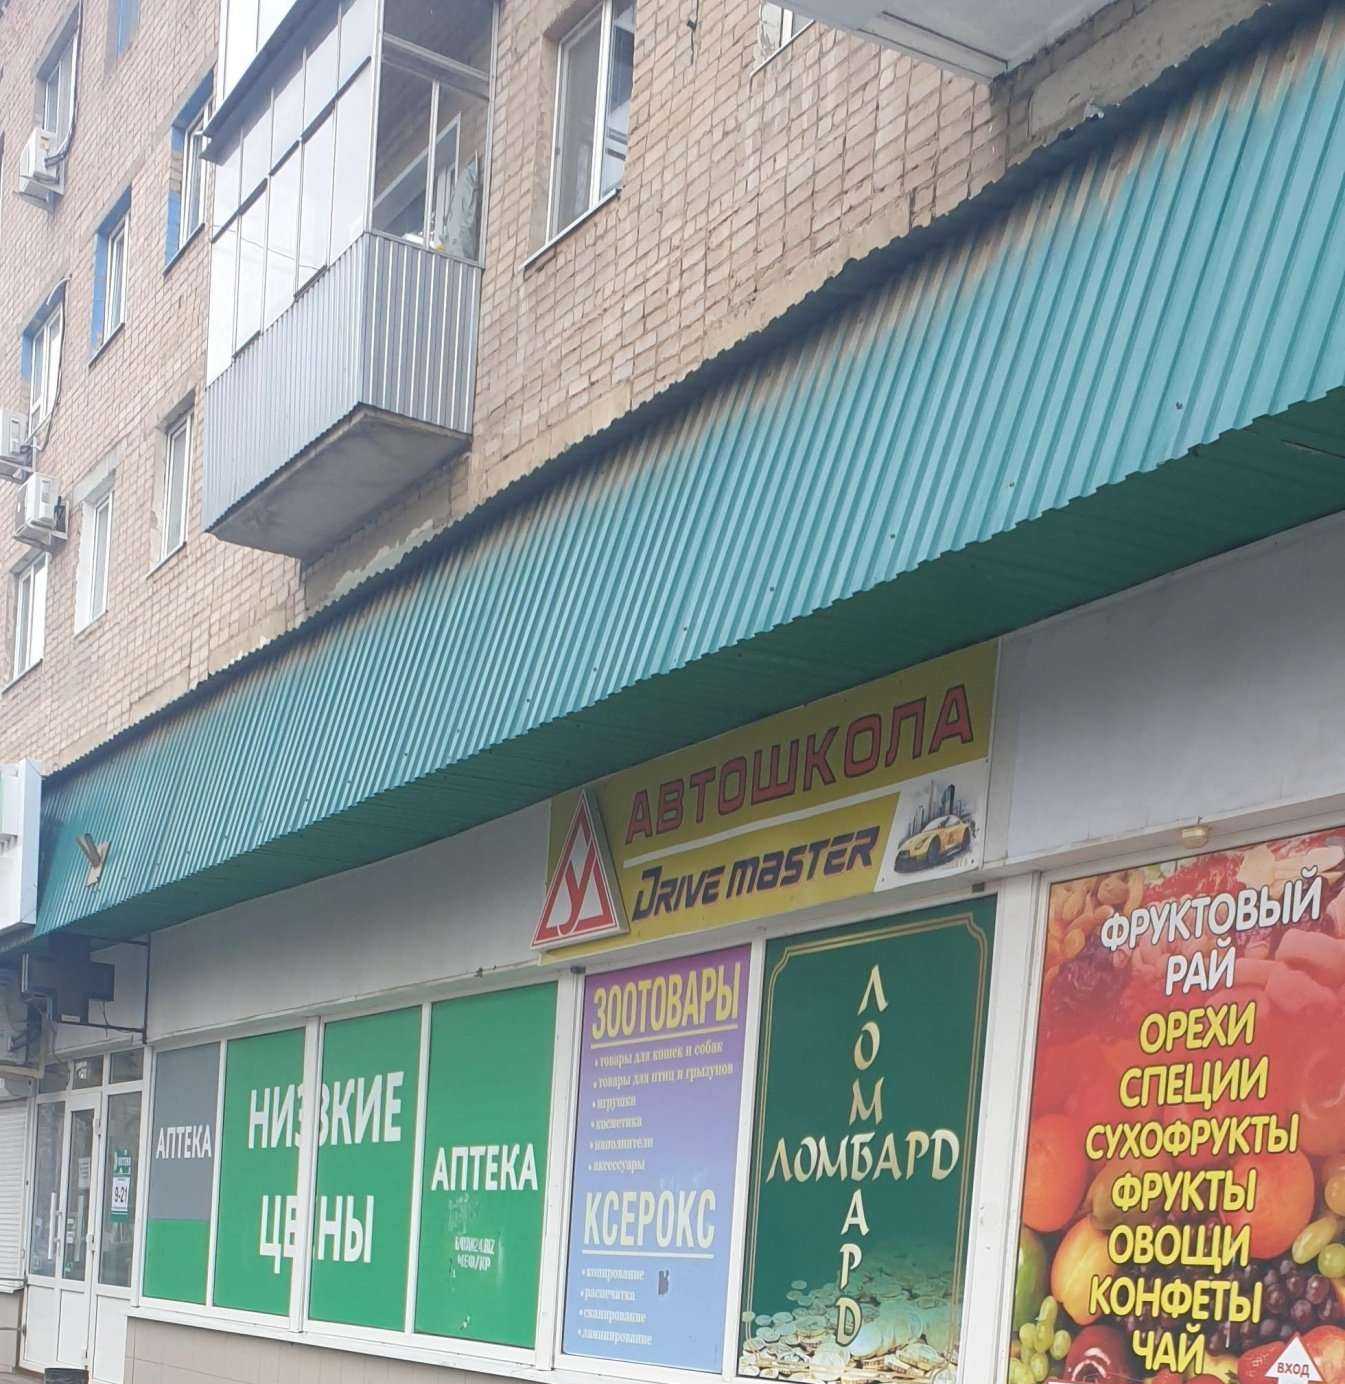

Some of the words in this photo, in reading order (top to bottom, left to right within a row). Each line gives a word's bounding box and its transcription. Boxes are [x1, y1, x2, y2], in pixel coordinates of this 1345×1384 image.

[625, 684, 974, 846] АВТОШКОЛА
[1101, 866, 1322, 951] ФРУКТОВЫЙ
[1165, 938, 1235, 995] РАЙ
[591, 962, 741, 1040] ЗООТОВАРЫ
[1140, 1001, 1256, 1053] ОРЕХИ
[694, 1039, 724, 1056] собак
[1119, 1056, 1269, 1110] СПЕЦИИ
[248, 1071, 404, 1149] НИЗКИЕ
[1086, 1113, 1299, 1160] СУХОФРУКТЫ
[156, 1124, 212, 1160] АПТЕКА
[431, 1142, 538, 1191] АПТЕКА
[766, 1129, 960, 1182] ЛОМБАРД
[835, 964, 888, 1346] ЛОМБАРД
[1112, 1168, 1257, 1212] ФРУКТЫ
[259, 1195, 375, 1274] ЦЕНЫ
[584, 1189, 716, 1248] КСЕРОКС
[1108, 1224, 1251, 1274] ОВОЩИ
[1089, 1275, 1262, 1324] КОНФЕТЫ
[1132, 1323, 1206, 1375] ЧАЙ
